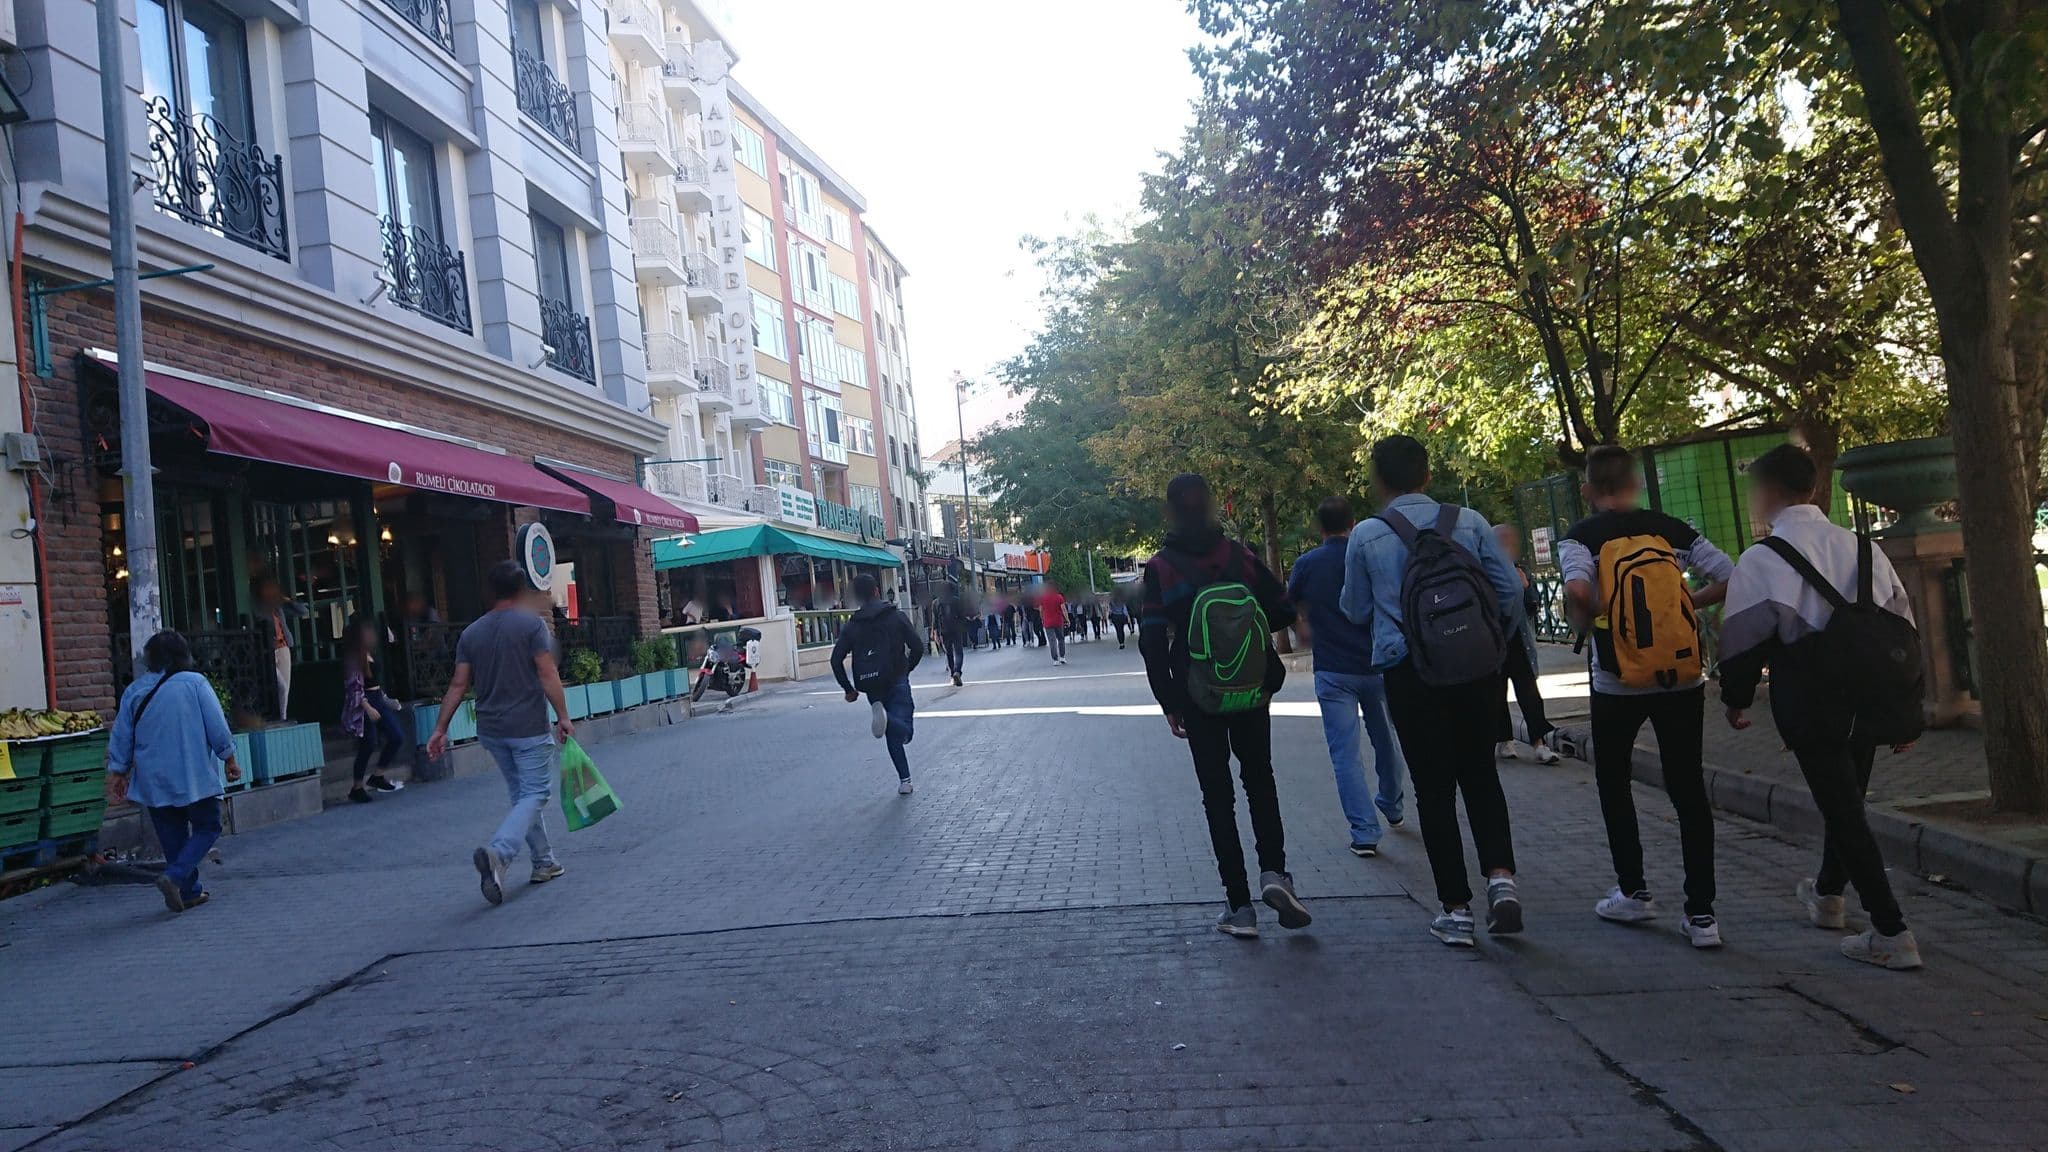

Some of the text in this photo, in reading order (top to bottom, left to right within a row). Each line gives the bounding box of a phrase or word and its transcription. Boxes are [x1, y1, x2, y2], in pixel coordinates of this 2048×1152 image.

[707, 103, 753, 406] ADA LIFE OTEL
[415, 472, 496, 496] RUMELİ ÇİKOLATACISI
